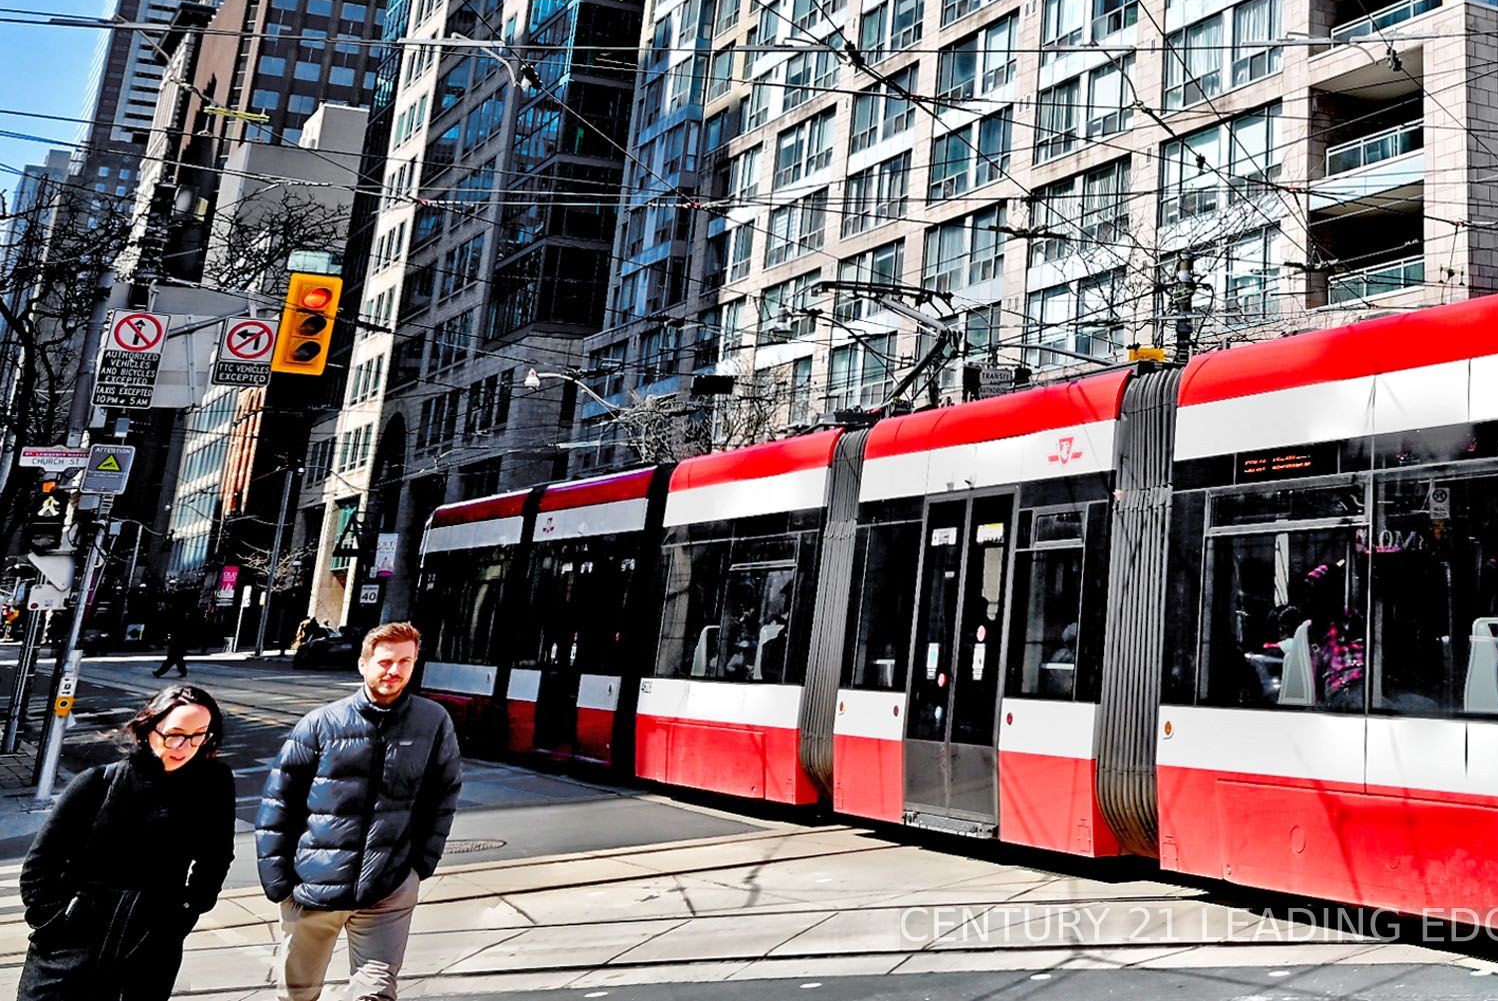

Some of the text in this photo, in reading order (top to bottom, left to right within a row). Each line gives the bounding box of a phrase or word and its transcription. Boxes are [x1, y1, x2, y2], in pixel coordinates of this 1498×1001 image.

[105, 351, 159, 361] AUTHORIZED
[110, 359, 151, 369] VEHICLES
[219, 363, 270, 374] TTC VEHICLES
[100, 367, 156, 378] AND BICYCLES
[219, 372, 266, 382] EXCEPTED
[105, 375, 148, 385] EXCEPTED
[96, 385, 153, 397] TAXIS EXCEPTED
[32, 457, 80, 466] CHURCH ST
[361, 592, 377, 601] 40
